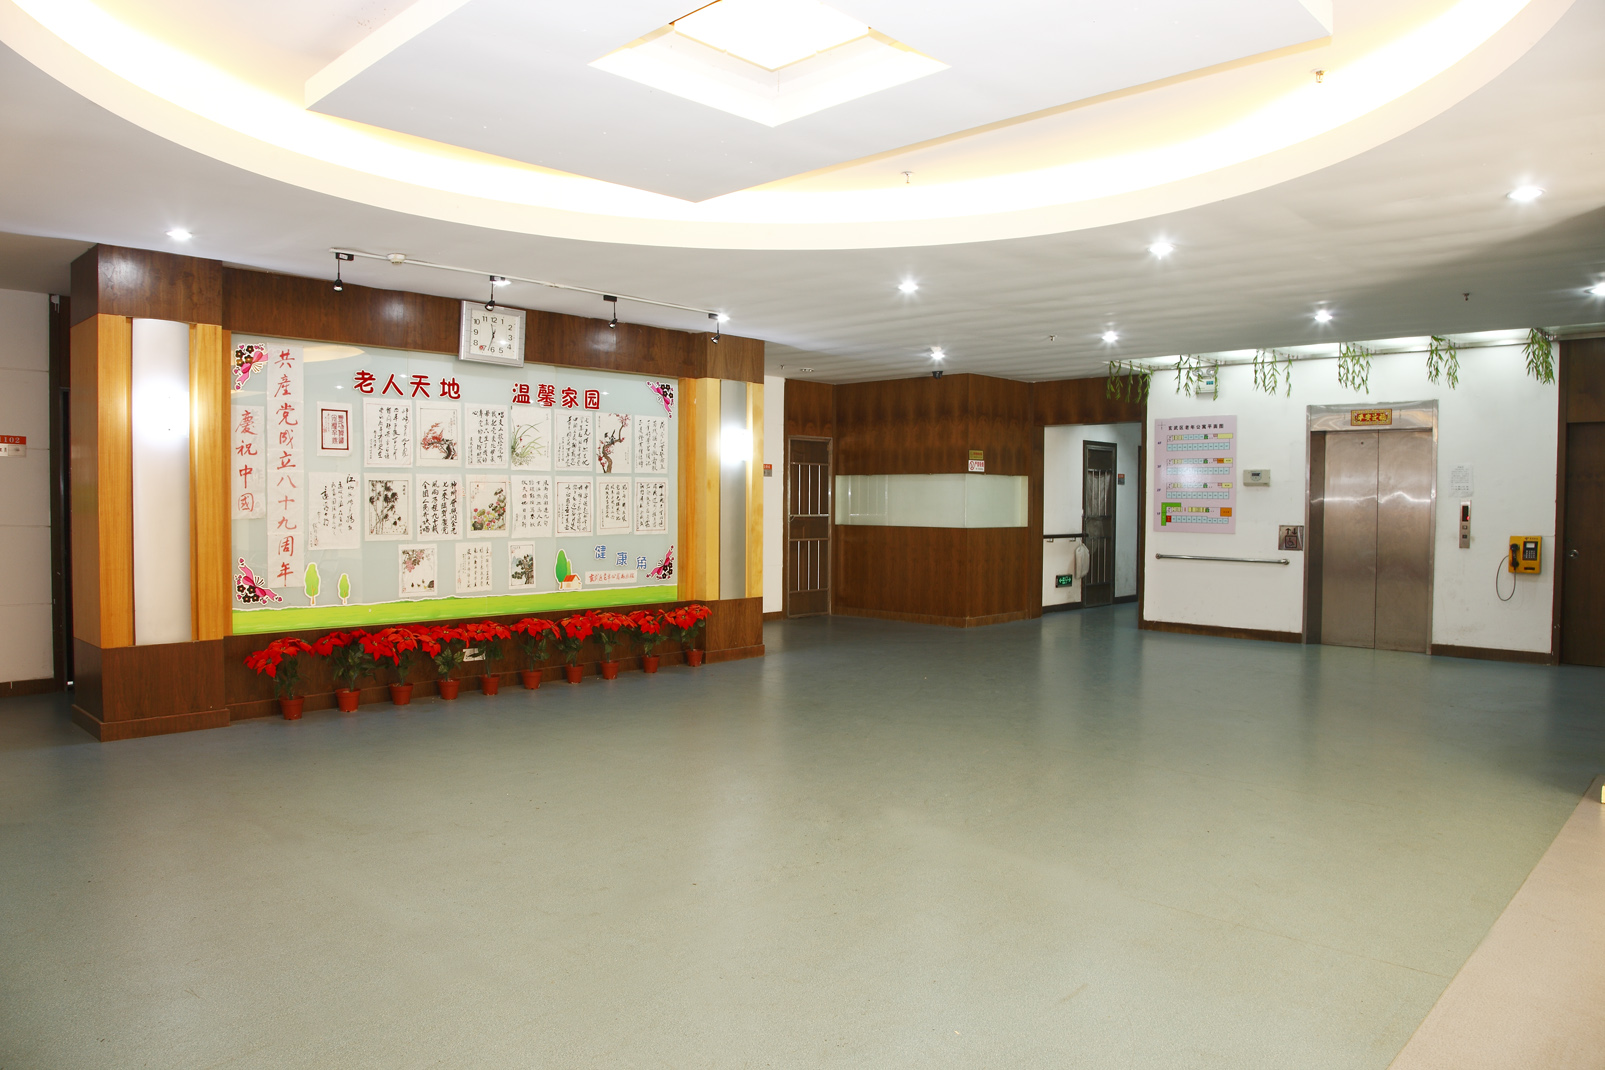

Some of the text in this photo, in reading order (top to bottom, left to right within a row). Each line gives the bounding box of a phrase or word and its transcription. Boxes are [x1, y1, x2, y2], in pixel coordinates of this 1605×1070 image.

[354, 370, 600, 410] 老人天地 温馨家园
[594, 545, 647, 569] 健康角
